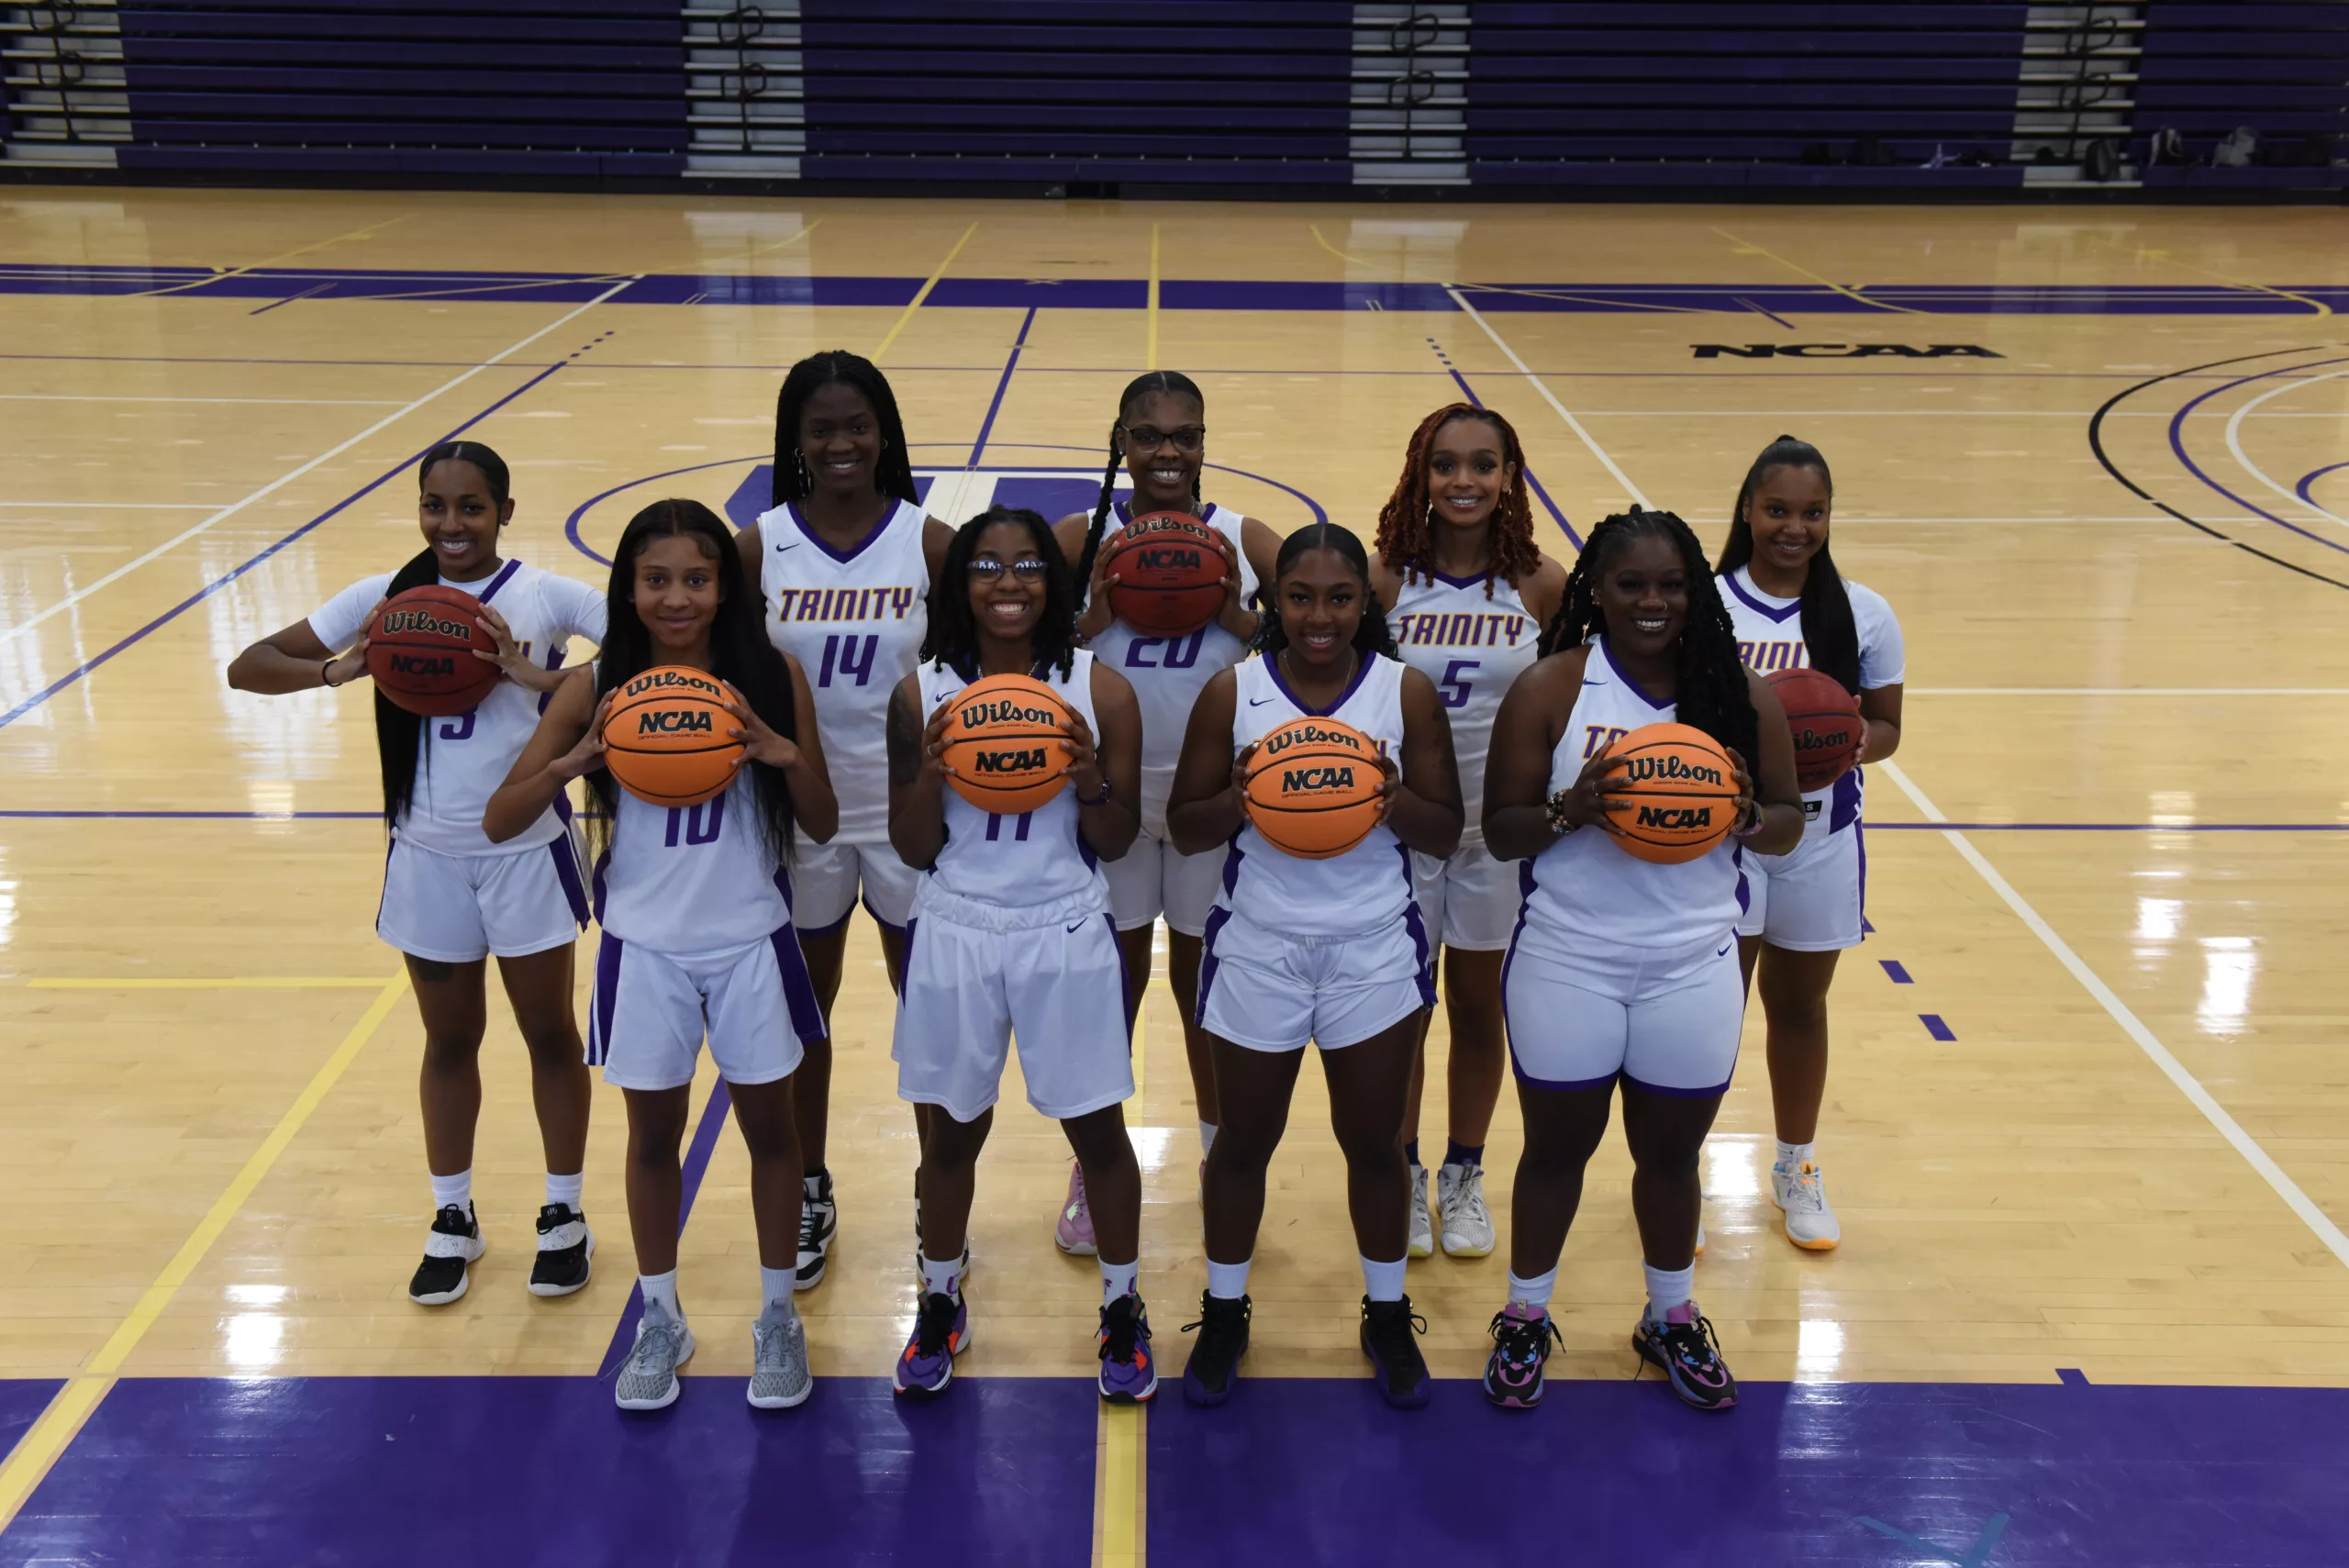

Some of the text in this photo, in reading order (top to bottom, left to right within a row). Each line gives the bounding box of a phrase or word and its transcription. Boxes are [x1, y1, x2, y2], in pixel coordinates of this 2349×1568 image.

[1689, 344, 2008, 359] NCAA
[1125, 517, 1212, 543] Wilson
[1136, 549, 1201, 570] NCAA
[780, 586, 913, 623] TRINITY
[383, 610, 472, 642] Wilson
[1397, 613, 1525, 647] TRINITY
[1125, 625, 1208, 668] 20
[390, 653, 455, 677] NCAA
[818, 635, 879, 687] 14
[626, 672, 722, 698] Wilson
[1438, 660, 1481, 708] 5
[638, 711, 713, 734] NCAA
[961, 699, 1055, 729] Wilson
[1265, 726, 1362, 755] Wilson
[1794, 728, 1850, 751] ilson
[975, 748, 1046, 773] NCAA
[1627, 756, 1722, 786] Wilson
[1282, 766, 1354, 792] NCAA
[664, 789, 727, 847] 10
[1636, 805, 1711, 829] NCAA
[1806, 803, 1814, 812] S
